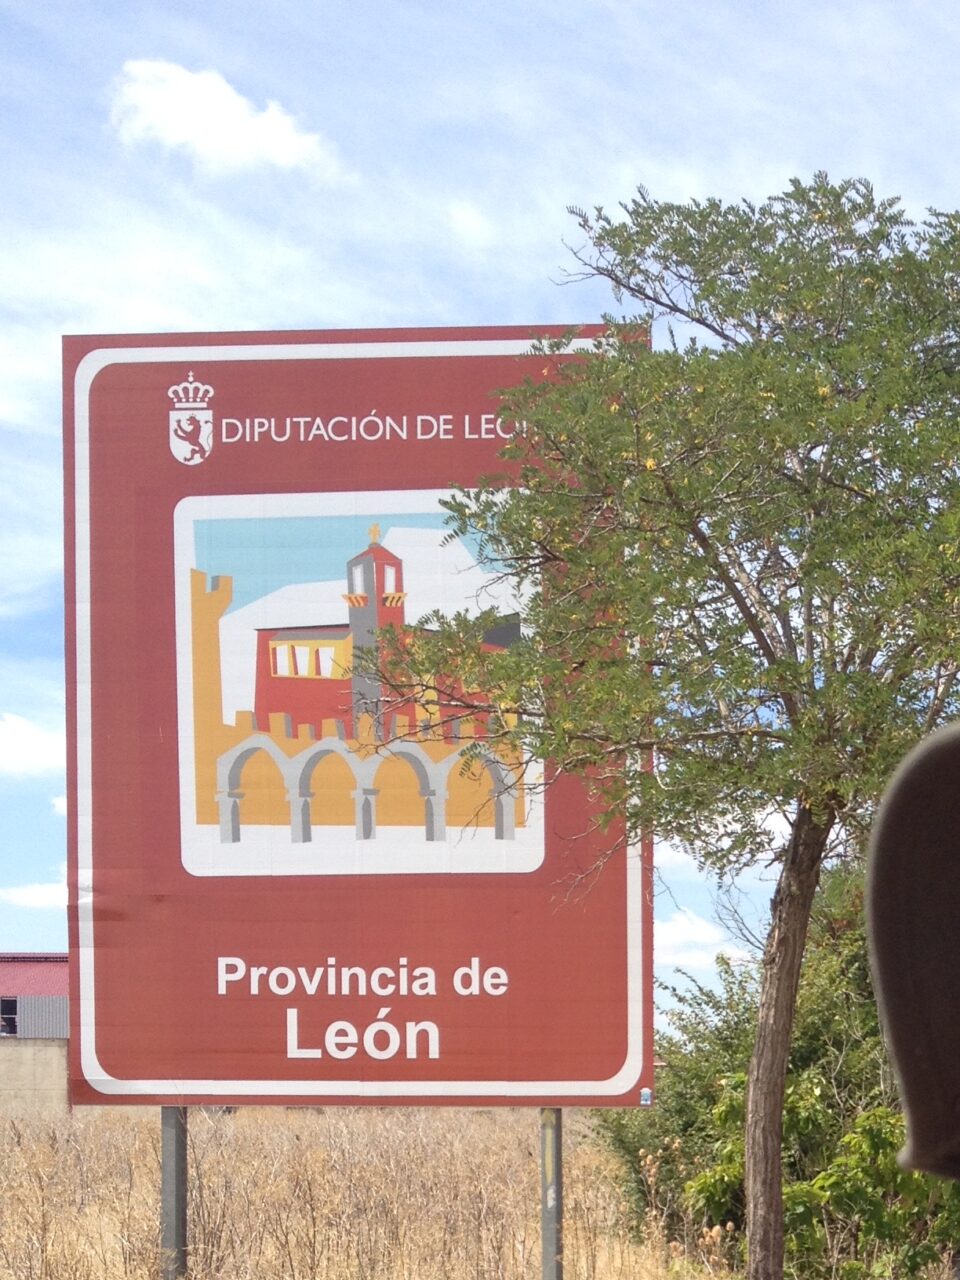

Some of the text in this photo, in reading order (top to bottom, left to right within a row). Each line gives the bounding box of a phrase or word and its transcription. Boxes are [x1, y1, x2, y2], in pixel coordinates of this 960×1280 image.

[221, 409, 407, 443] DIPUTACIÓN
[416, 414, 454, 440] DE
[217, 956, 509, 996] Provincia de
[286, 1007, 440, 1060] León
